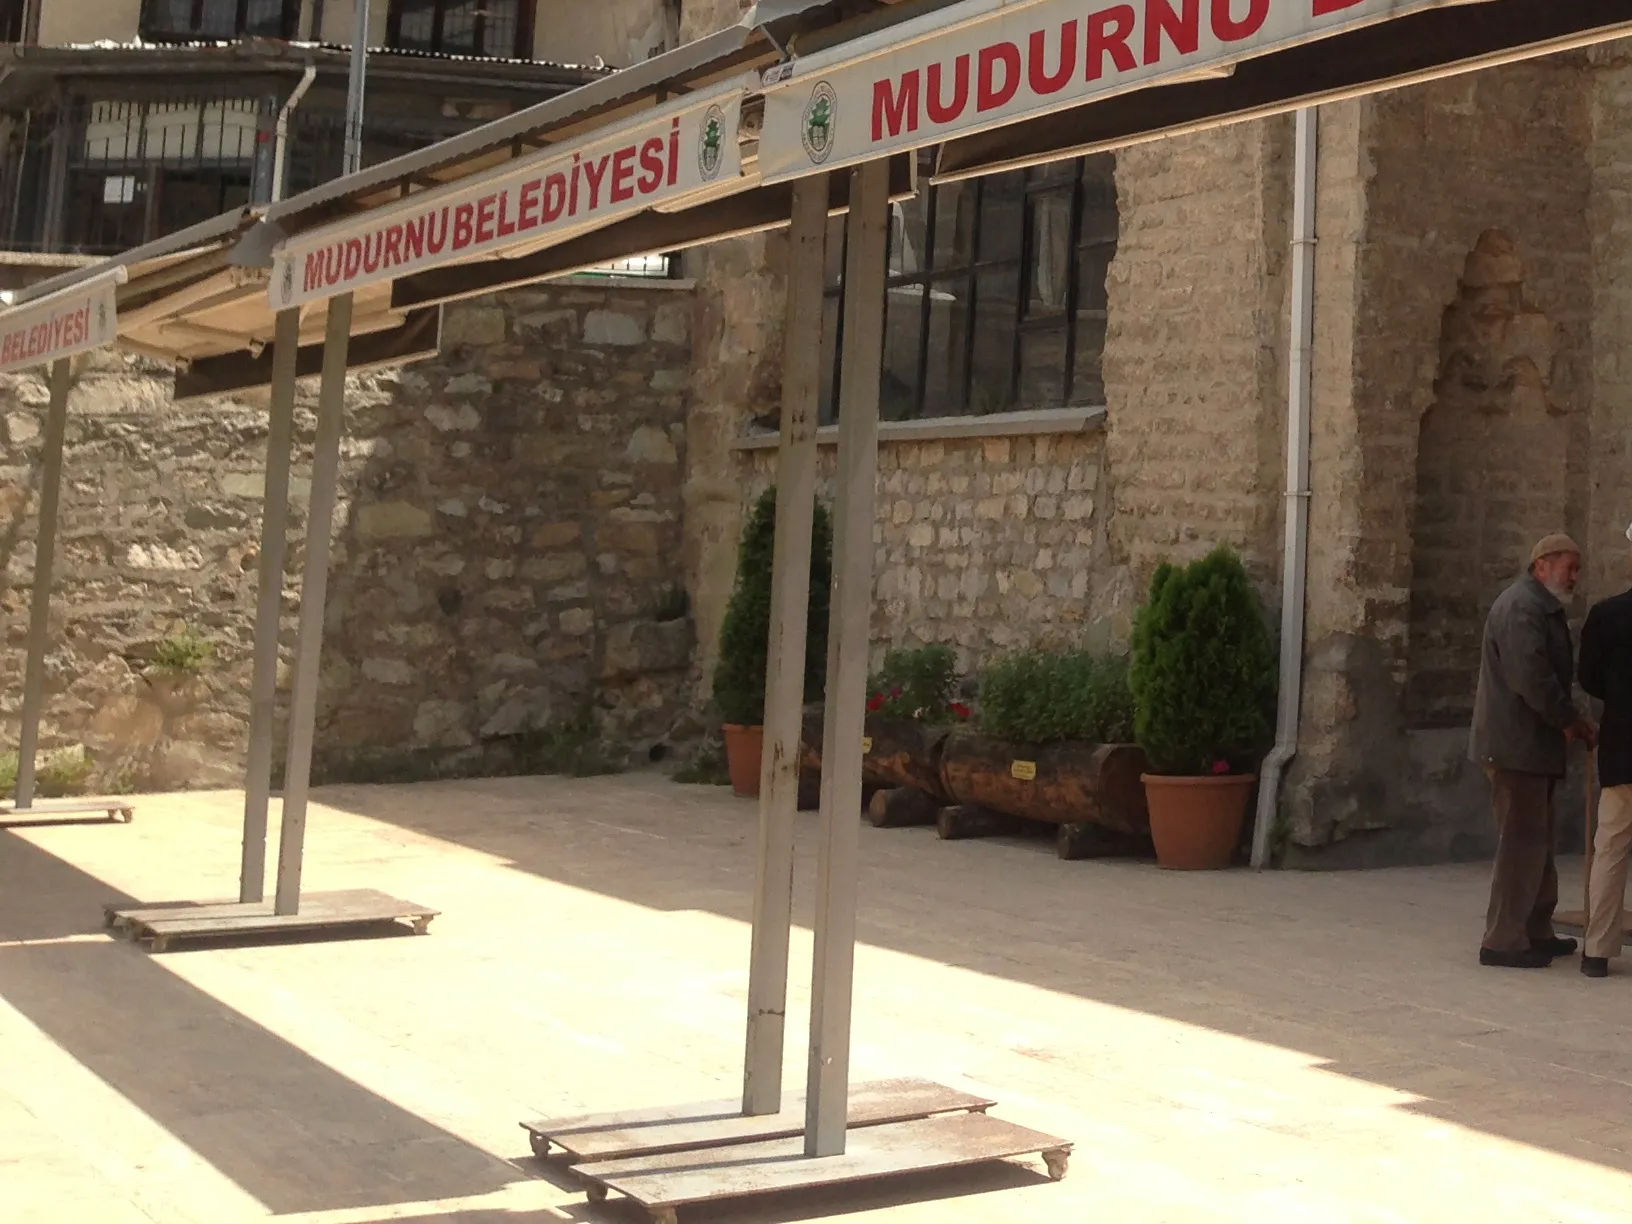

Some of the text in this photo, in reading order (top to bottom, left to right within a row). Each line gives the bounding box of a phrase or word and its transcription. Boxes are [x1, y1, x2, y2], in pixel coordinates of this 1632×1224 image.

[303, 206, 451, 293] MUDURNU
[452, 117, 681, 251] BELEDİYESİ
[1, 297, 92, 365] BELEDİYESİ
